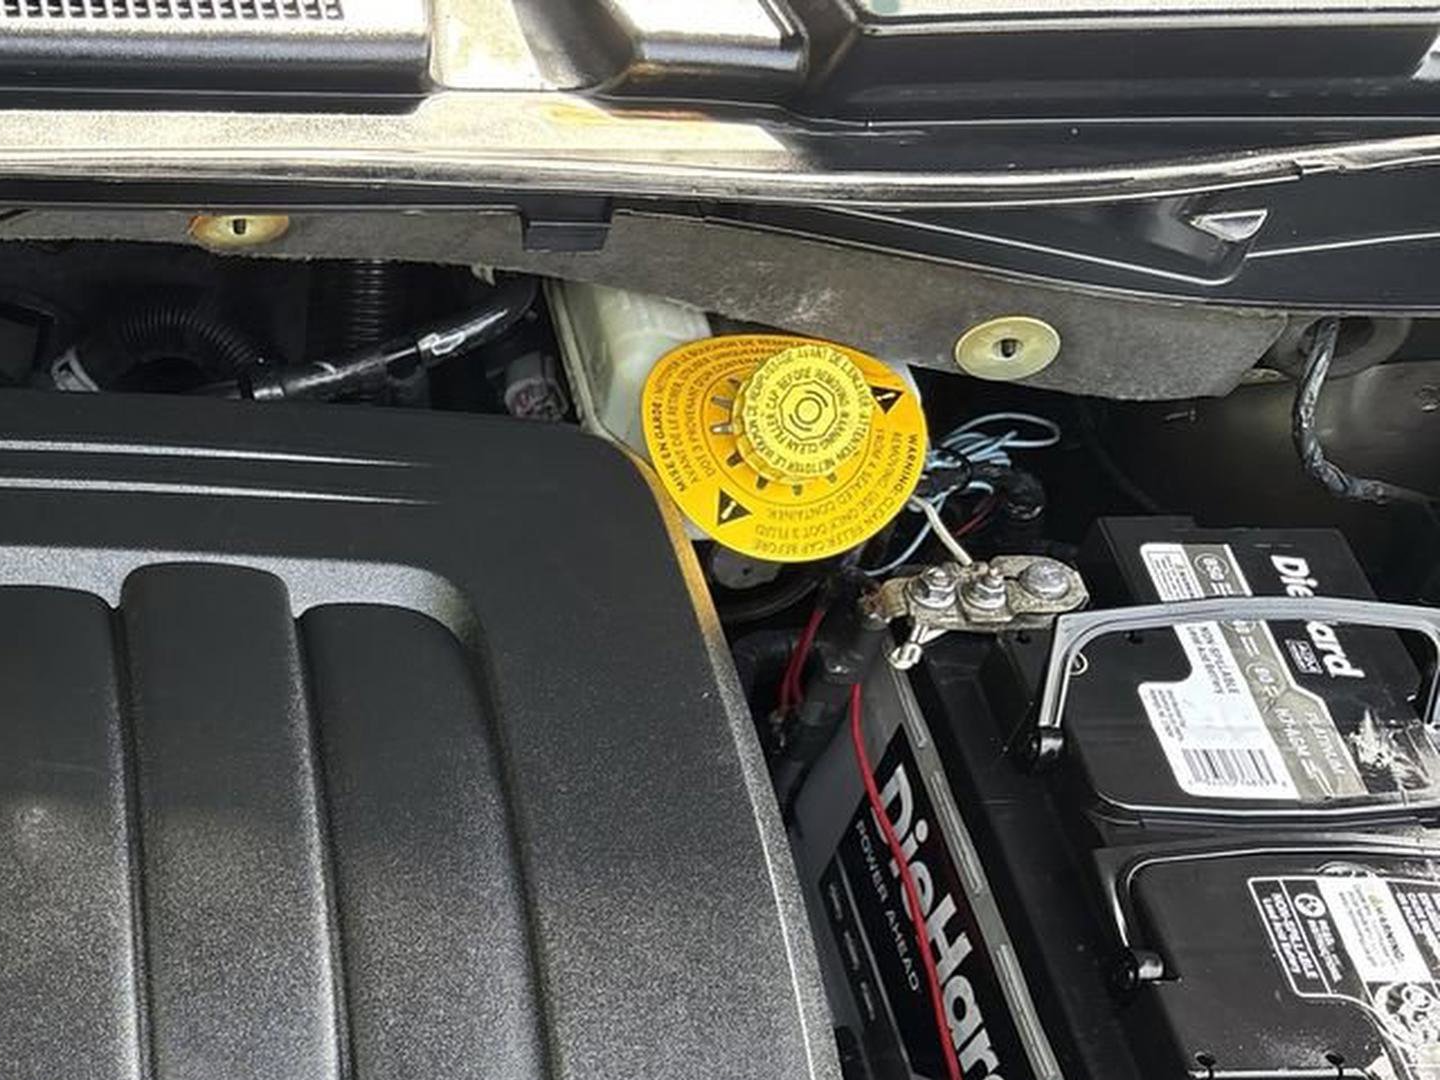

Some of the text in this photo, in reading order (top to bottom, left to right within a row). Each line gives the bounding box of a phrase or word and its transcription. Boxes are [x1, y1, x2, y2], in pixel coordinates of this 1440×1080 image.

[891, 433, 919, 496] WARNING:
[1270, 554, 1366, 679] Dieard
[855, 819, 920, 993] POWER AHEAD
